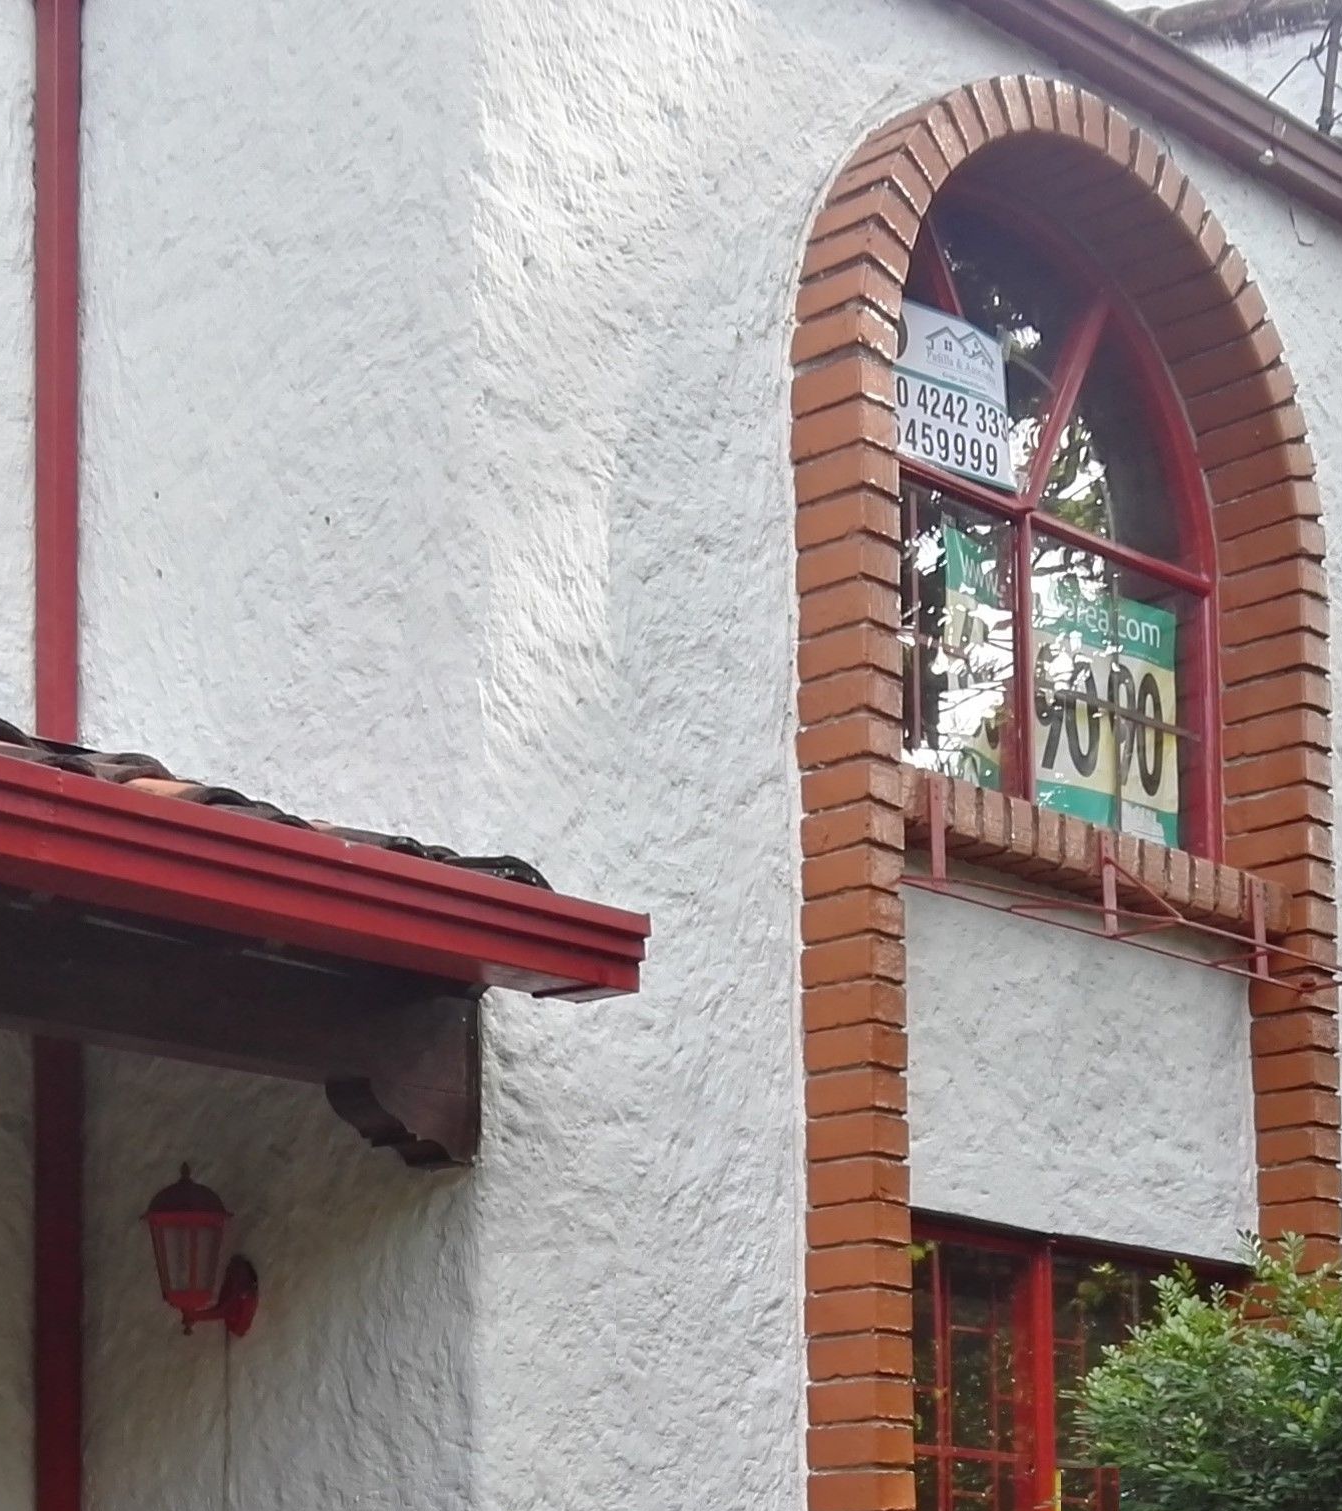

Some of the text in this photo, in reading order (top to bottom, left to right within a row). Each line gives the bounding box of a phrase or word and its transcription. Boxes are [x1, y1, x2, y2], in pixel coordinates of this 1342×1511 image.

[896, 376, 909, 408] 0
[917, 384, 969, 428] 4242
[975, 402, 1008, 443] 333
